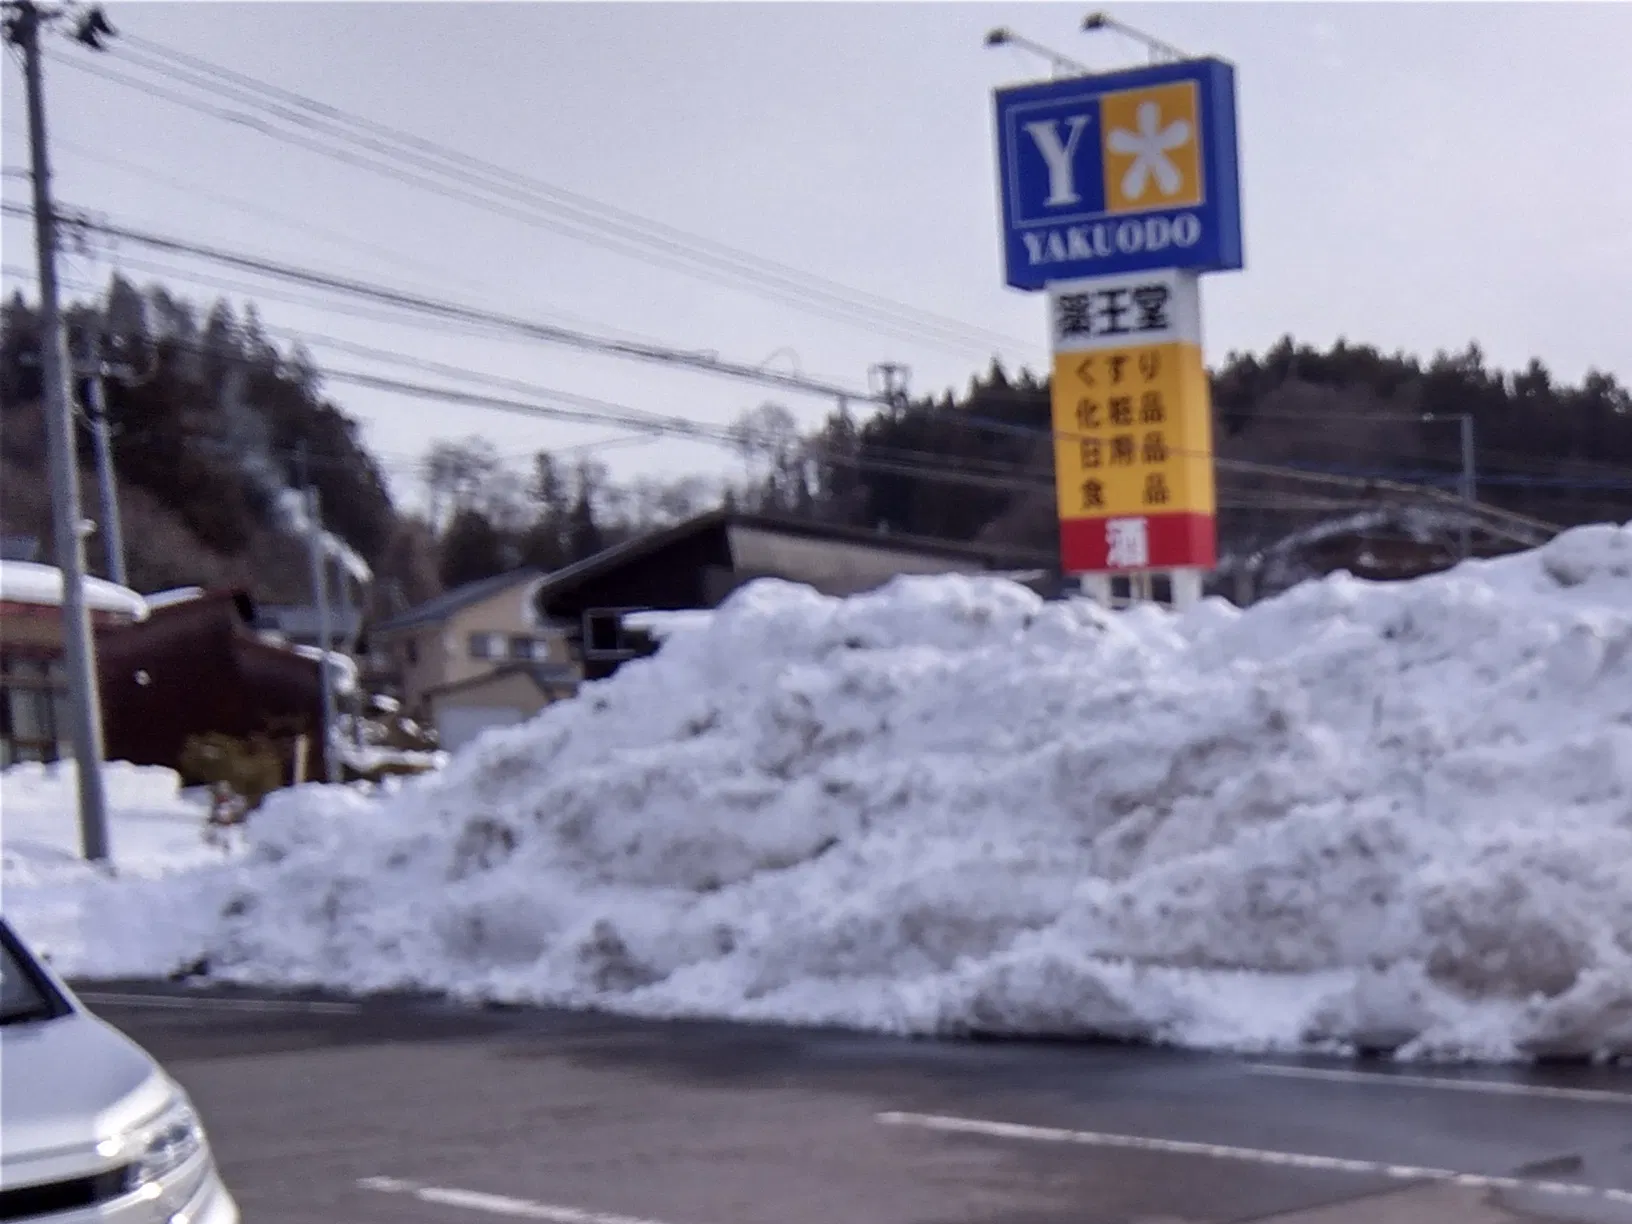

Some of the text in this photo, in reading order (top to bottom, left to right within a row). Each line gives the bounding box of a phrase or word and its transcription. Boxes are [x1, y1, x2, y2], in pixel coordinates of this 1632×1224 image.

[1021, 115, 1092, 207] Y
[1022, 213, 1202, 265] YAKUODO
[1058, 285, 1170, 338] 薬王堂
[1075, 350, 1161, 388] くすり
[1076, 390, 1165, 429] 化粧品
[1080, 431, 1166, 468] 日用品
[1105, 516, 1148, 568] 酒
